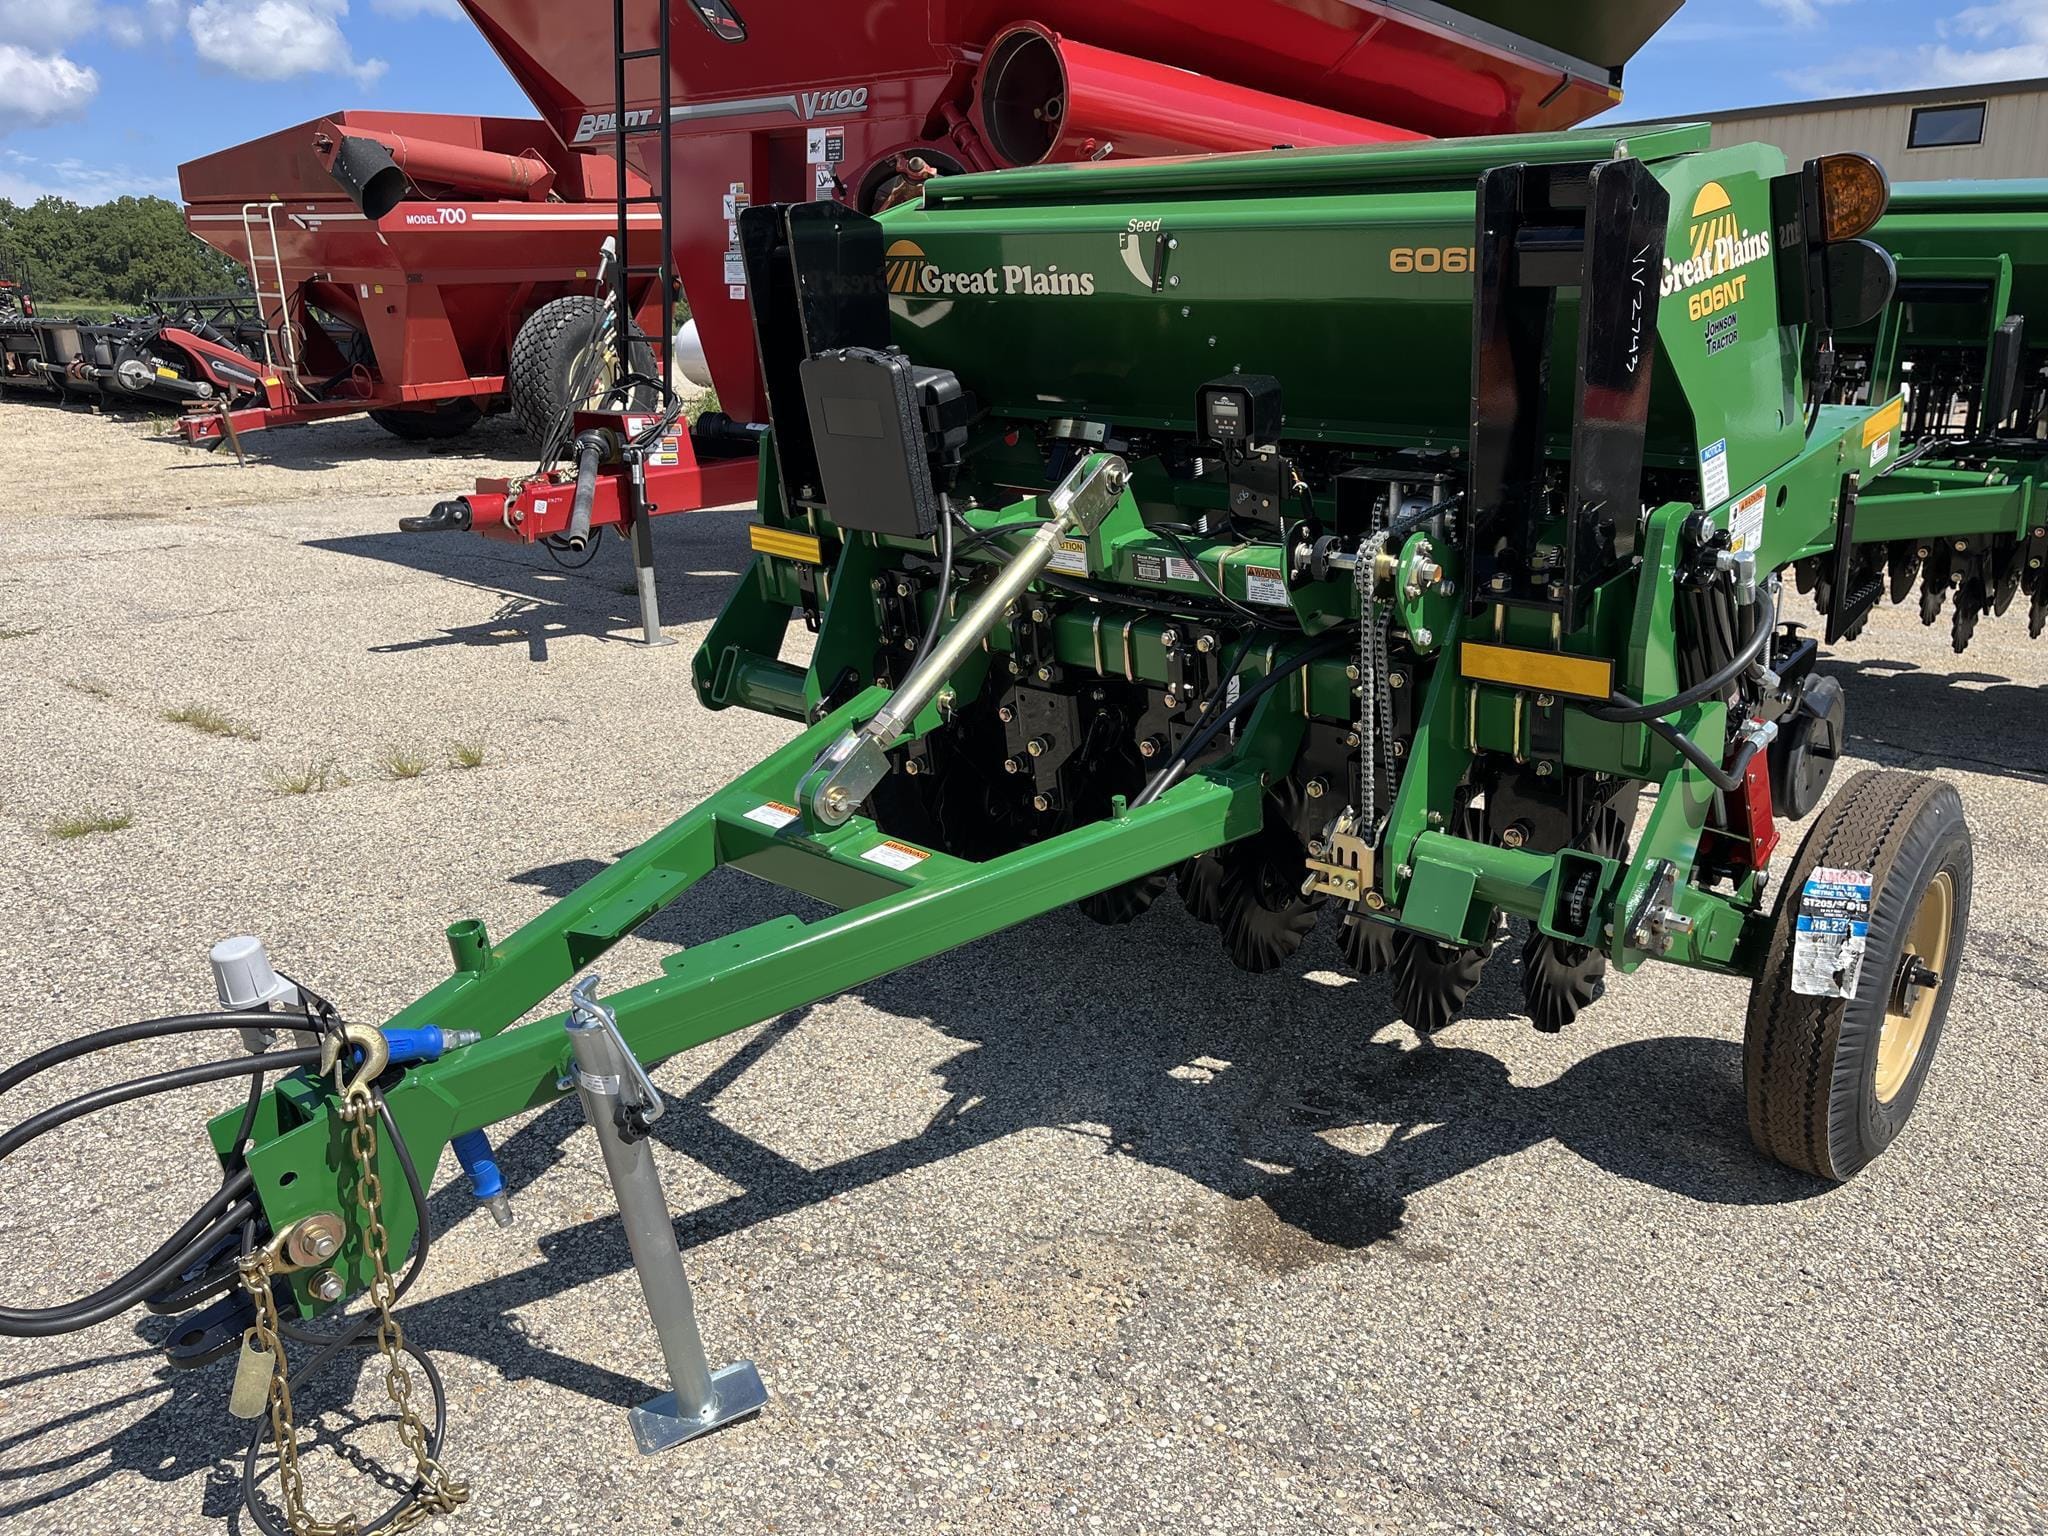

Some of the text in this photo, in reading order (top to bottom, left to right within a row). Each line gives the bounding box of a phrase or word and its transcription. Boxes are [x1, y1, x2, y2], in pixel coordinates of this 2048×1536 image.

[801, 87, 868, 120] V1100
[406, 208, 467, 225] MODEL 700
[1127, 218, 1162, 233] Seed
[1119, 232, 1126, 248] F
[1659, 228, 1770, 298] Great Plains
[920, 264, 1095, 296] Great Plains
[1688, 274, 1747, 322] 606NT
[1704, 312, 1737, 339] JOHNSON
[1705, 330, 1738, 356] TRACTOR
[1060, 541, 1083, 551] UTION
